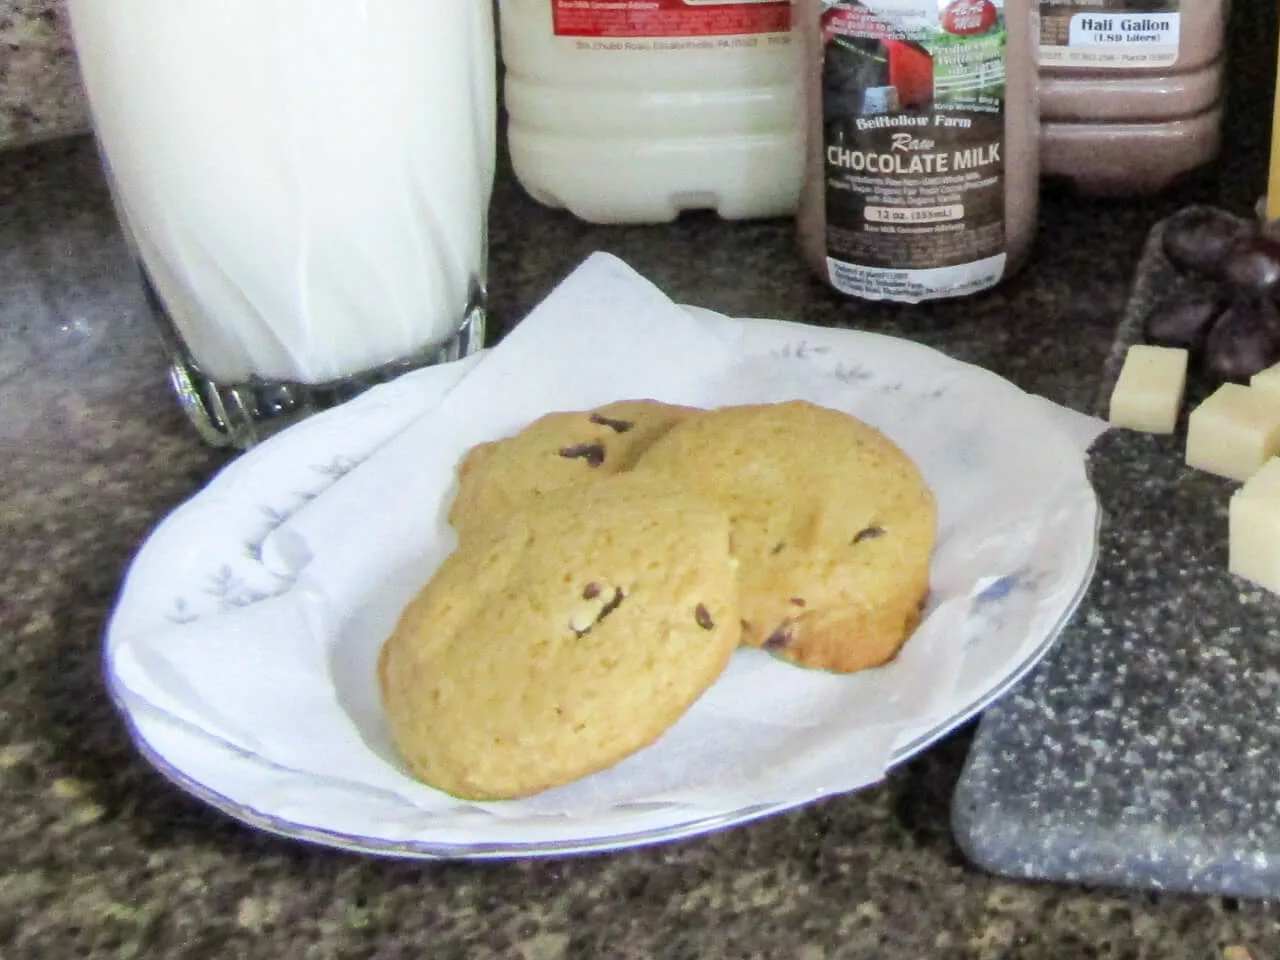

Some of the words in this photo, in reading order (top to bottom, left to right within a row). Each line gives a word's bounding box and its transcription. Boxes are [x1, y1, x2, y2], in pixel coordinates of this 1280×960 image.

[1081, 19, 1113, 32] Half
[1120, 19, 1170, 32] Gallon
[855, 114, 929, 130] BelHollow
[934, 114, 972, 129] Farm
[891, 132, 935, 153] Raw
[826, 145, 949, 174] CHOCOLATE
[953, 142, 1001, 171] MILK
[877, 210, 890, 219] 12
